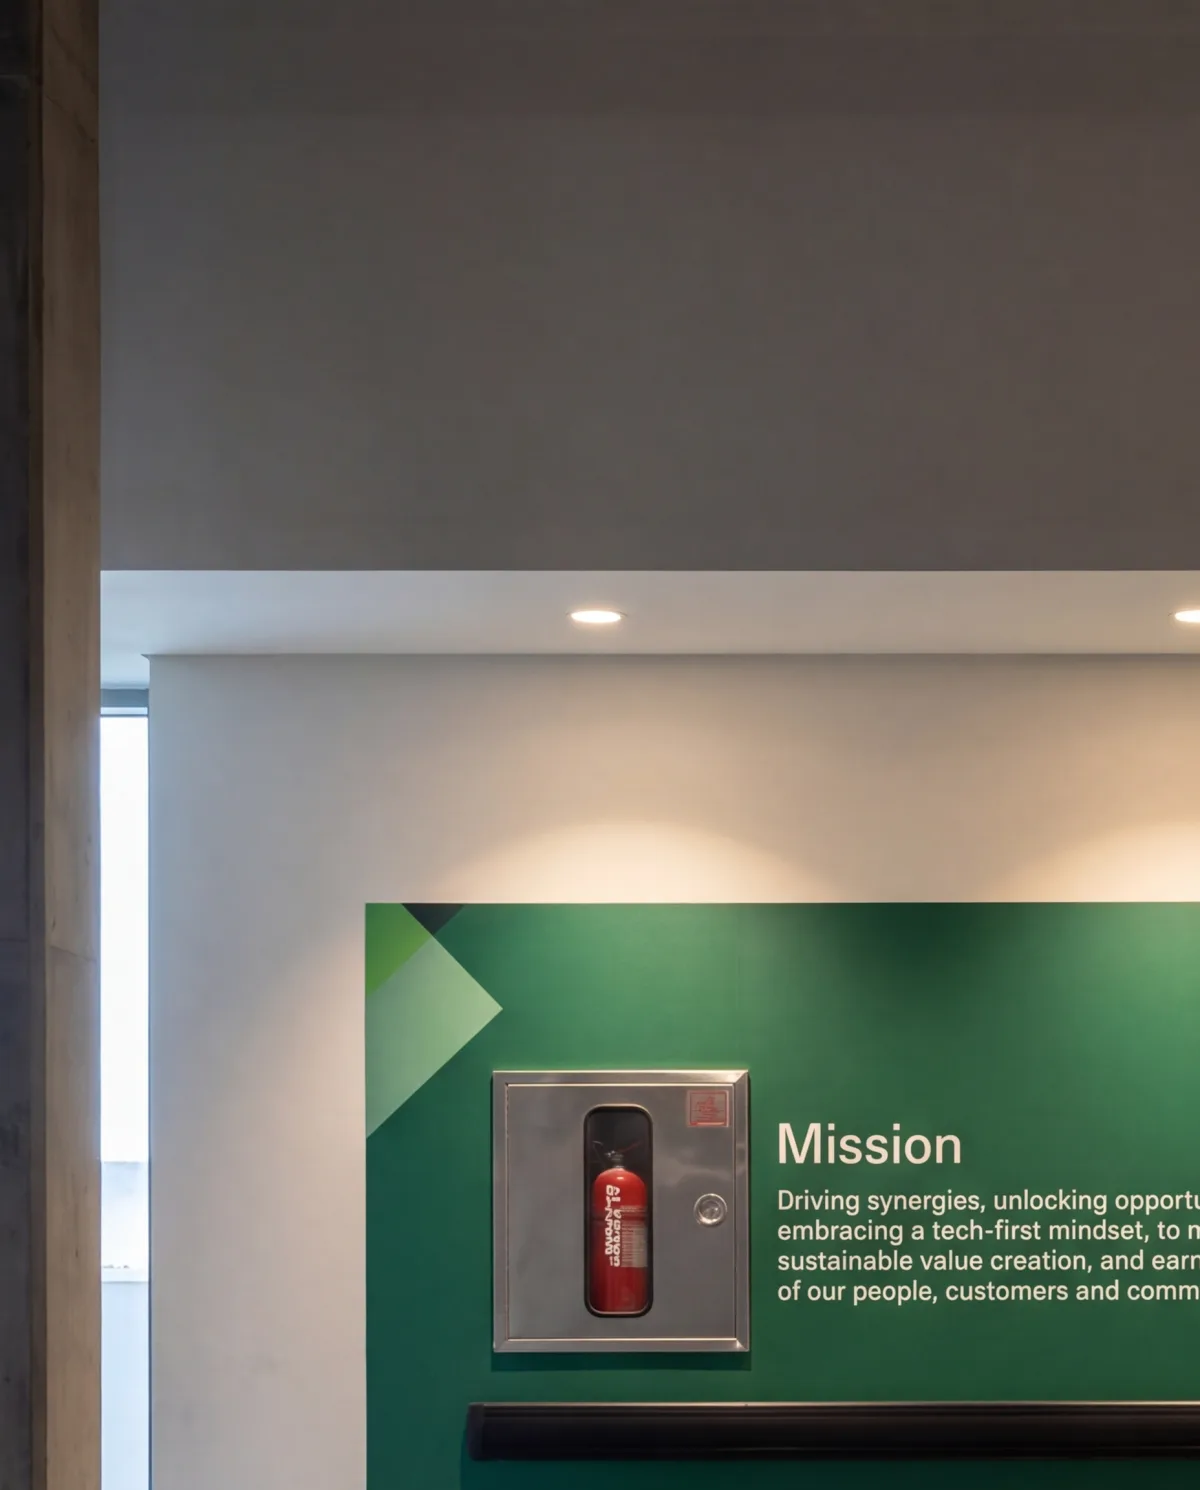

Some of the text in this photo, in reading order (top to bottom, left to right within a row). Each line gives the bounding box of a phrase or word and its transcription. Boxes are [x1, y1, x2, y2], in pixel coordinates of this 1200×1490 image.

[778, 1122, 961, 1165] Mission
[778, 1188, 860, 1217] Driving
[867, 1188, 986, 1216] synergies,
[994, 1188, 1108, 1216] unlocking
[777, 1218, 903, 1246] embracing
[911, 1224, 925, 1241] a
[931, 1218, 1041, 1241] tech-first
[1049, 1218, 1150, 1244] mindset,
[1156, 1221, 1181, 1241] to
[777, 1249, 913, 1271] sustainable
[919, 1249, 983, 1271] value
[990, 1248, 1093, 1274] creation,
[1100, 1248, 1144, 1271] and
[777, 1279, 802, 1301] of
[807, 1284, 847, 1301] our
[853, 1279, 938, 1306] people,
[945, 1281, 1069, 1301] customers
[1075, 1278, 1119, 1301] and
